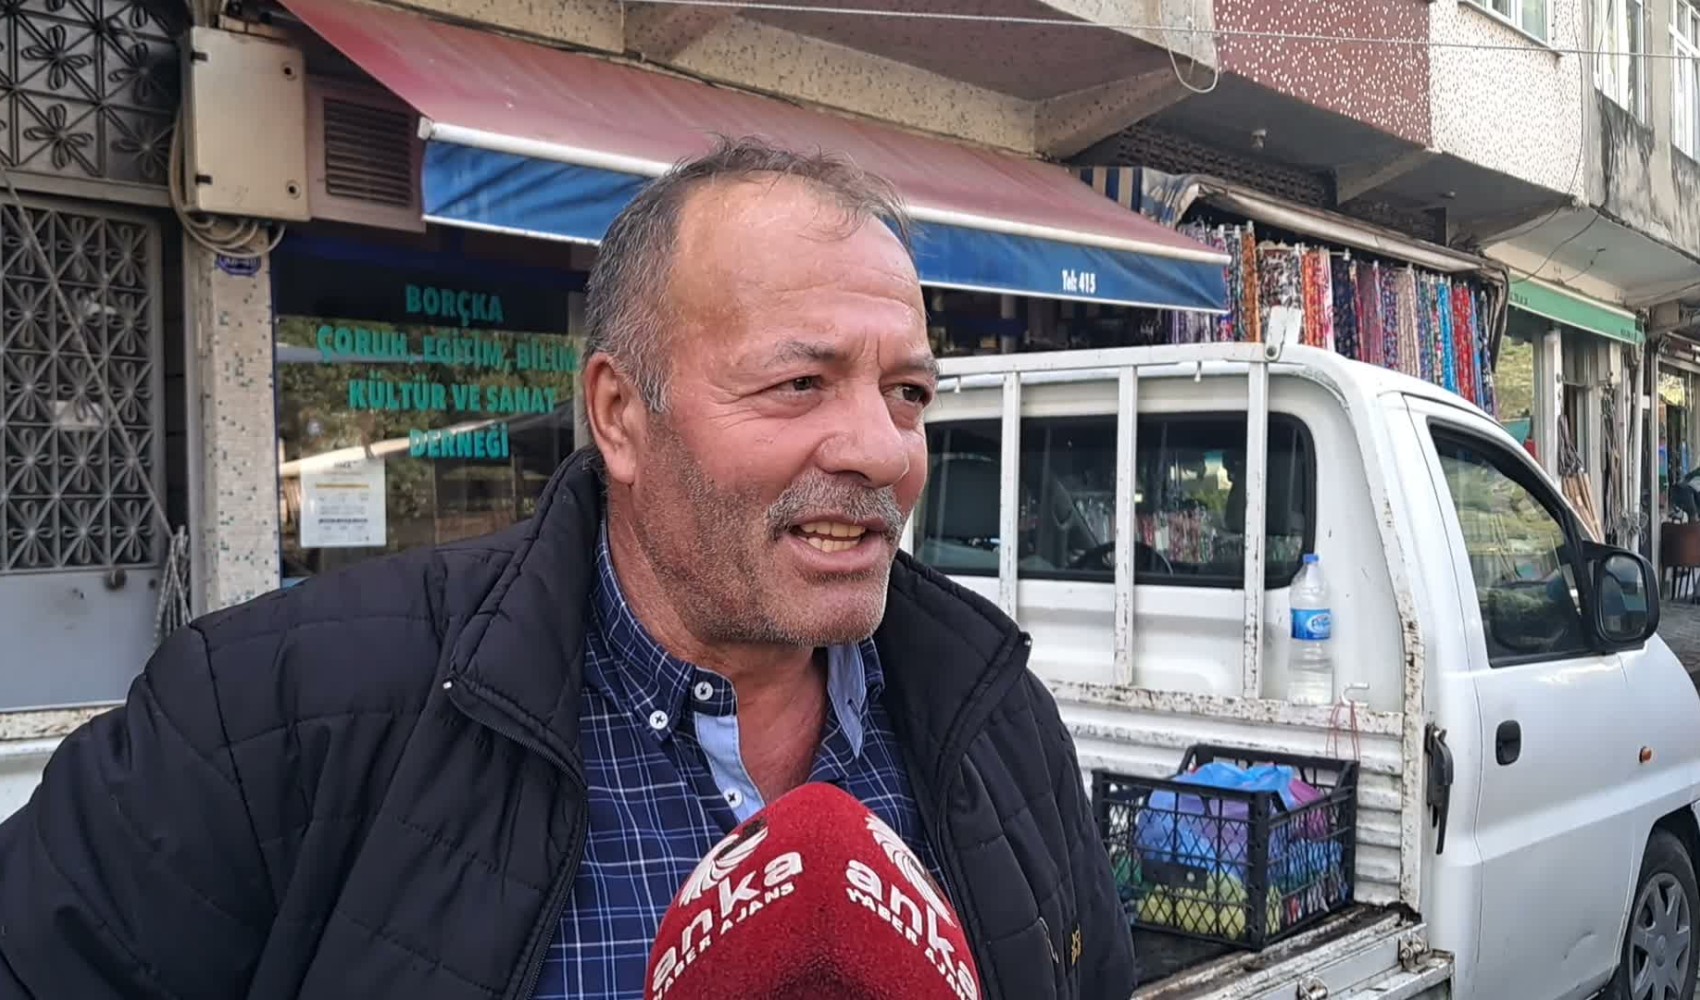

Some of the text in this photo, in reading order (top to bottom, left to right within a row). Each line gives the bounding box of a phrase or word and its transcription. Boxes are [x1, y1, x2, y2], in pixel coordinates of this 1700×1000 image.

[406, 284, 503, 326] BORÇKA
[1079, 272, 1096, 293] 415
[349, 370, 557, 413] KÜLTÜR VE SANAT
[409, 422, 509, 458] DERNEĞİ
[652, 851, 803, 991] anka
[720, 881, 795, 935] AJANS
[845, 859, 978, 1000] anka
[846, 887, 968, 1000] HABER AJAN
